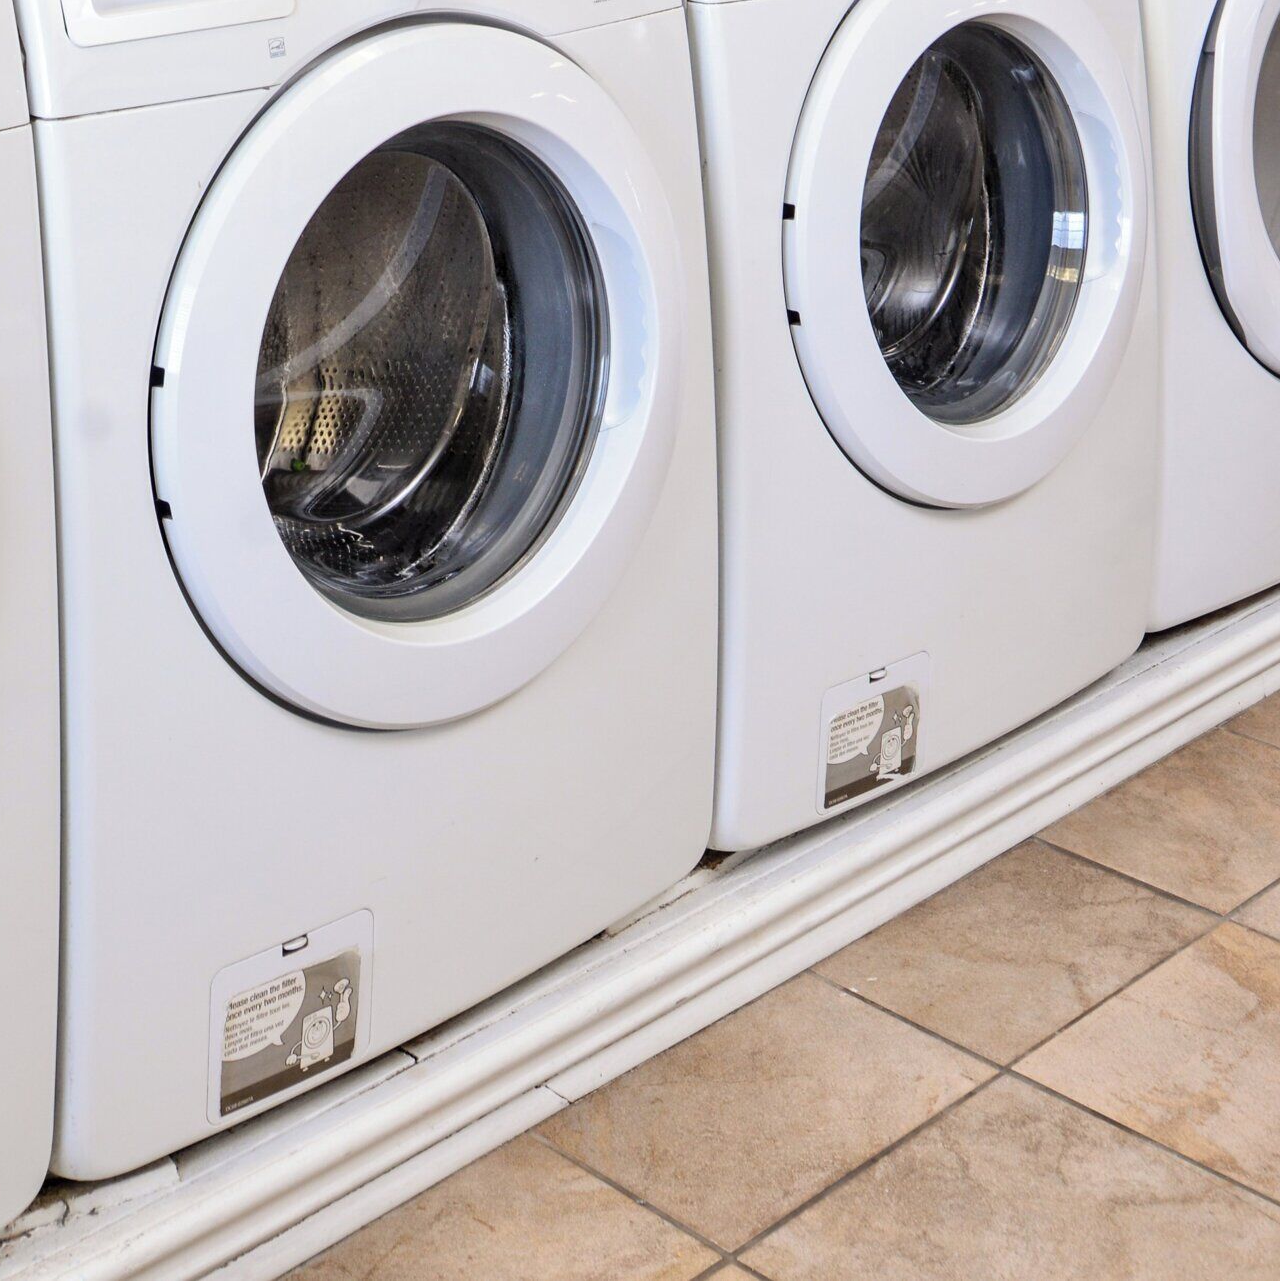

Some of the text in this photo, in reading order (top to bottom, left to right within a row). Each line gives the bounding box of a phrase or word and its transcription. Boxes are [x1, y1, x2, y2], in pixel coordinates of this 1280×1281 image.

[250, 989, 269, 1003] clean
[269, 984, 280, 994] the
[281, 977, 297, 989] filter
[243, 1002, 263, 1015] every
[263, 996, 277, 1007] two
